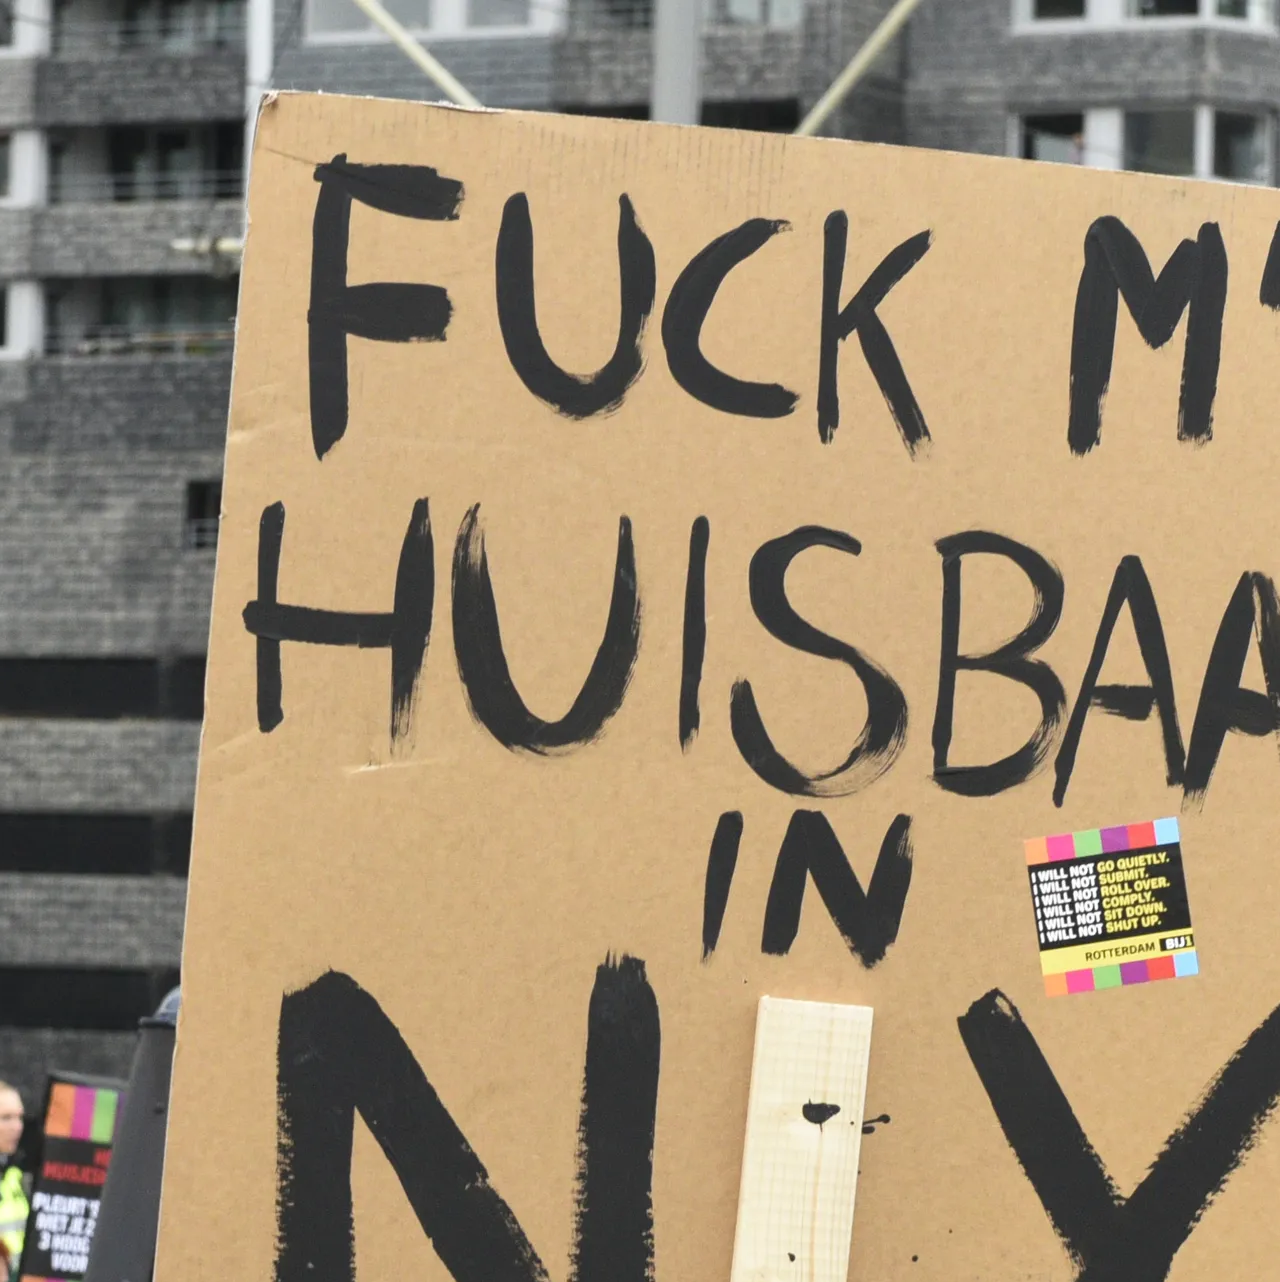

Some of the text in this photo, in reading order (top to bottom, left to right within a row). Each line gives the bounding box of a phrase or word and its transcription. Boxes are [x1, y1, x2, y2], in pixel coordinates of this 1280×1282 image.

[308, 154, 932, 461] FUCK
[1037, 867, 1068, 882] WILL
[1069, 862, 1095, 878] NOT
[1097, 860, 1115, 873] GO
[1116, 851, 1170, 870] QUIETLY.
[1039, 879, 1070, 894] WILL
[1071, 874, 1096, 890] NOT
[1098, 867, 1149, 885] SUBMIT.
[700, 809, 913, 969] IN
[1041, 891, 1072, 906] WILL
[1072, 886, 1098, 902] NOT
[1100, 882, 1132, 897] ROLL
[1133, 876, 1170, 892] OVER.
[1042, 903, 1074, 918] WILL
[1074, 899, 1100, 914] NOT
[1102, 890, 1155, 909] COMPLY.
[1044, 916, 1075, 930] WILL
[1076, 911, 1102, 926] NOT
[1104, 907, 1123, 921] SIT
[1125, 901, 1167, 918] DOWN.
[1046, 928, 1077, 942] WILL
[1078, 922, 1104, 938] NOT
[1105, 917, 1139, 933] SHUT
[1141, 914, 1162, 928] UP.
[1085, 935, 1192, 960] ROTTERDAM BIJ1
